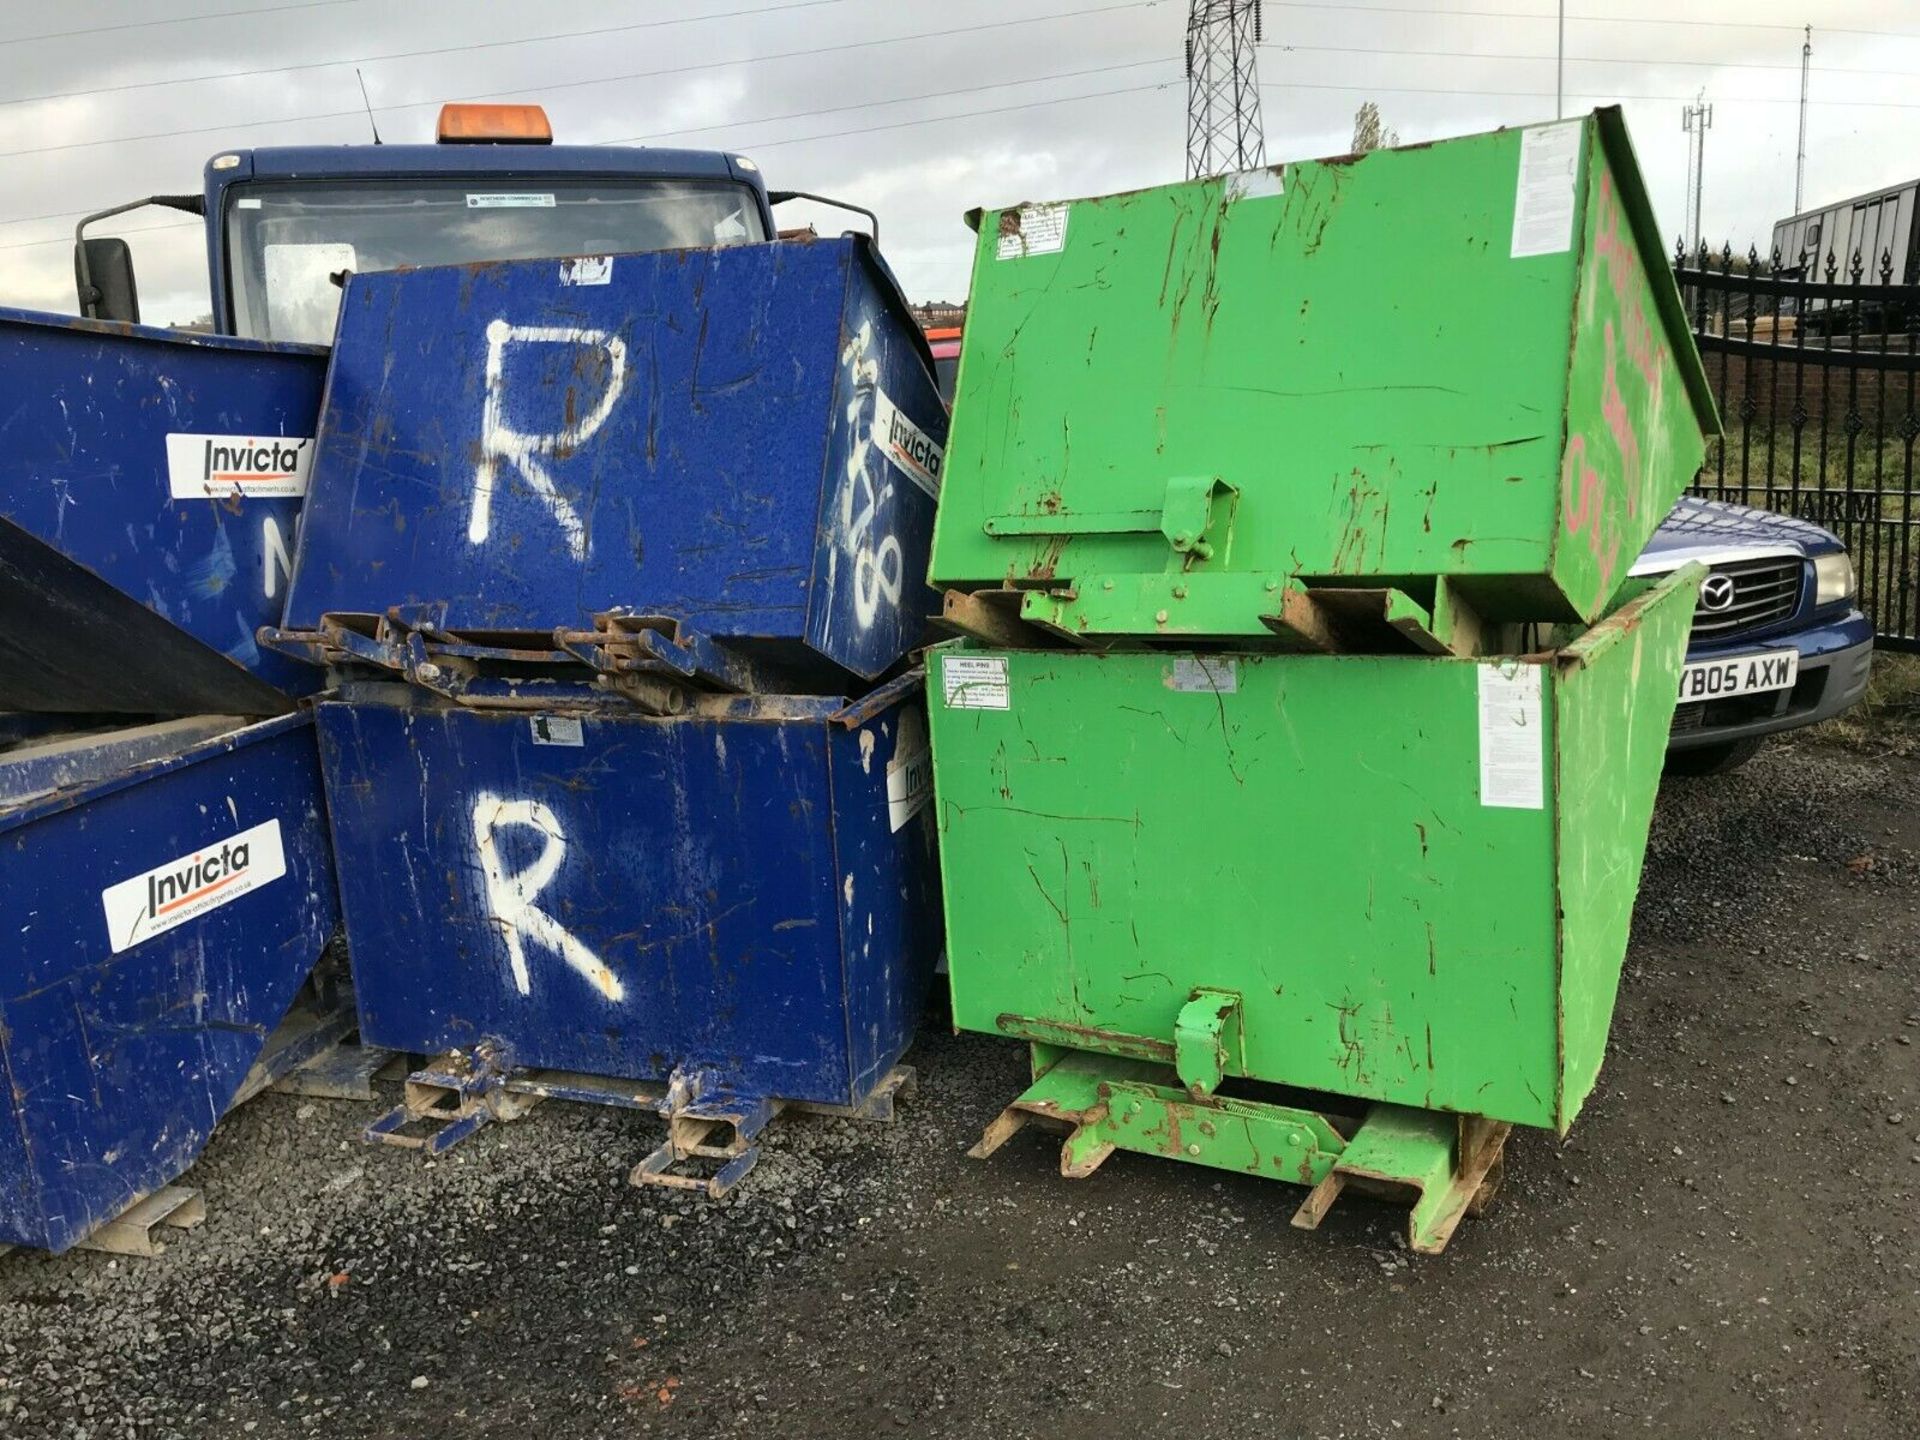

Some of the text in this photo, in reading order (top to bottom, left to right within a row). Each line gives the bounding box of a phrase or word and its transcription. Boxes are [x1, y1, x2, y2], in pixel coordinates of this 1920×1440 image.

[204, 438, 299, 480] Invicta
[468, 319, 626, 562] R
[889, 409, 941, 477] Invicta
[1774, 489, 1880, 521] FARM
[1744, 656, 1790, 690] AXW
[148, 842, 250, 919] Invicta
[474, 790, 624, 1001] R
